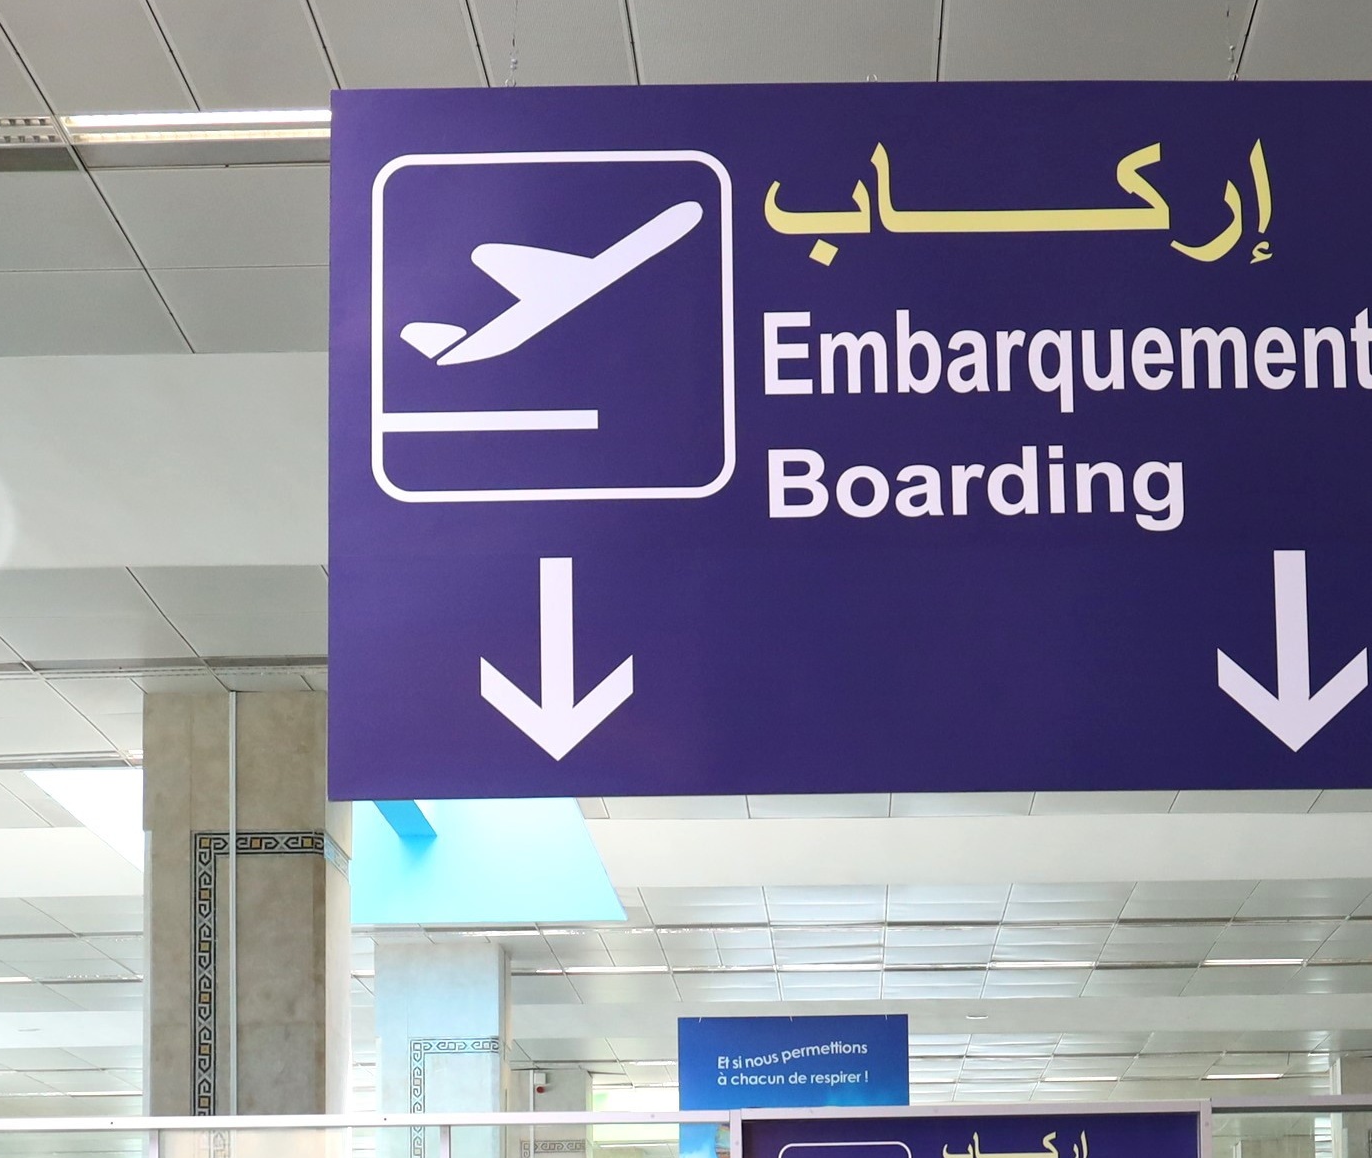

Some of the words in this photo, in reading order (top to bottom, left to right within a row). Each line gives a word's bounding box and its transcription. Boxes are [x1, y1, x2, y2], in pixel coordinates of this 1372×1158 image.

[764, 138, 1274, 266] إركاب
[767, 444, 1186, 531] Boarding
[717, 1055, 730, 1069] Et
[732, 1054, 742, 1069] si
[745, 1054, 779, 1069] nous
[781, 1041, 868, 1064] permettions
[717, 1071, 727, 1086] à
[730, 1072, 785, 1085] chacun
[788, 1071, 808, 1085] de
[810, 1071, 861, 1086] respirer
